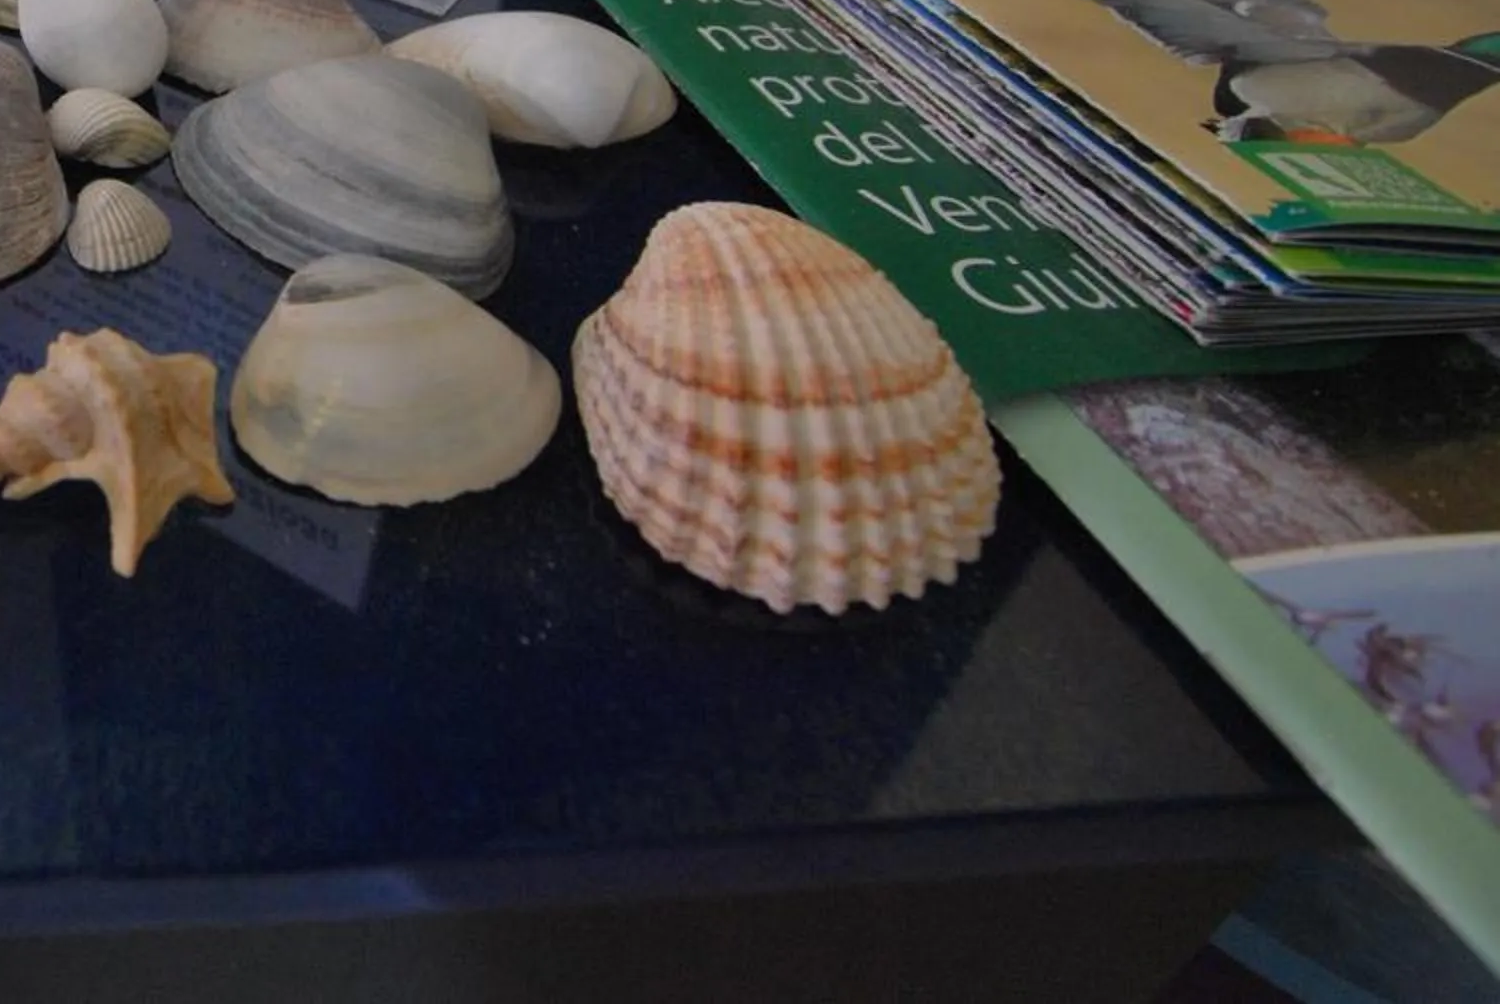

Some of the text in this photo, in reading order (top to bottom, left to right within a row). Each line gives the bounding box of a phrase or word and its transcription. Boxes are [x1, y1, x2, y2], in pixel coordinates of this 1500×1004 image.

[751, 72, 902, 118] prot
[813, 121, 935, 167] del
[951, 253, 1139, 314] Giul
